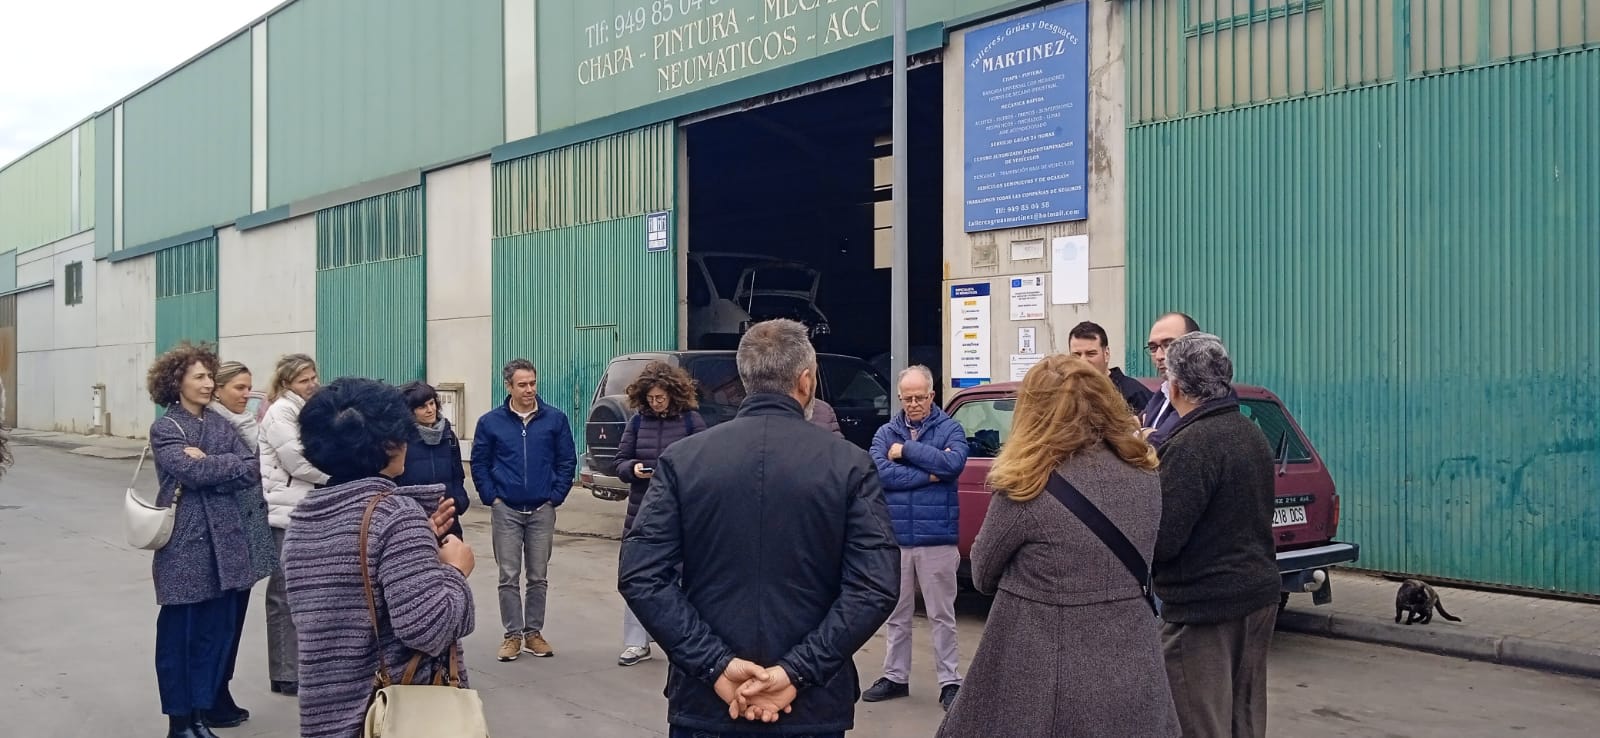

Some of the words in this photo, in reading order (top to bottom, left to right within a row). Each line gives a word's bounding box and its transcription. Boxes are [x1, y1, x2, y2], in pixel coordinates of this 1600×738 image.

[578, 45, 634, 85] CHAPA
[653, 8, 739, 60] PINTURA
[585, 20, 608, 48] Tlf:
[614, 7, 646, 38] 949
[652, 0, 673, 25] 85
[658, 26, 796, 93] NEUMATICOS
[824, 0, 881, 44] ACC
[970, 35, 1004, 69] Talleres,
[1006, 22, 1030, 36] Grúas
[1030, 22, 1037, 31] y
[1038, 20, 1079, 45] Desguaces
[982, 39, 1065, 73] MARTINEZ
[1272, 509, 1287, 524] 218
[1290, 508, 1304, 522] DCS
